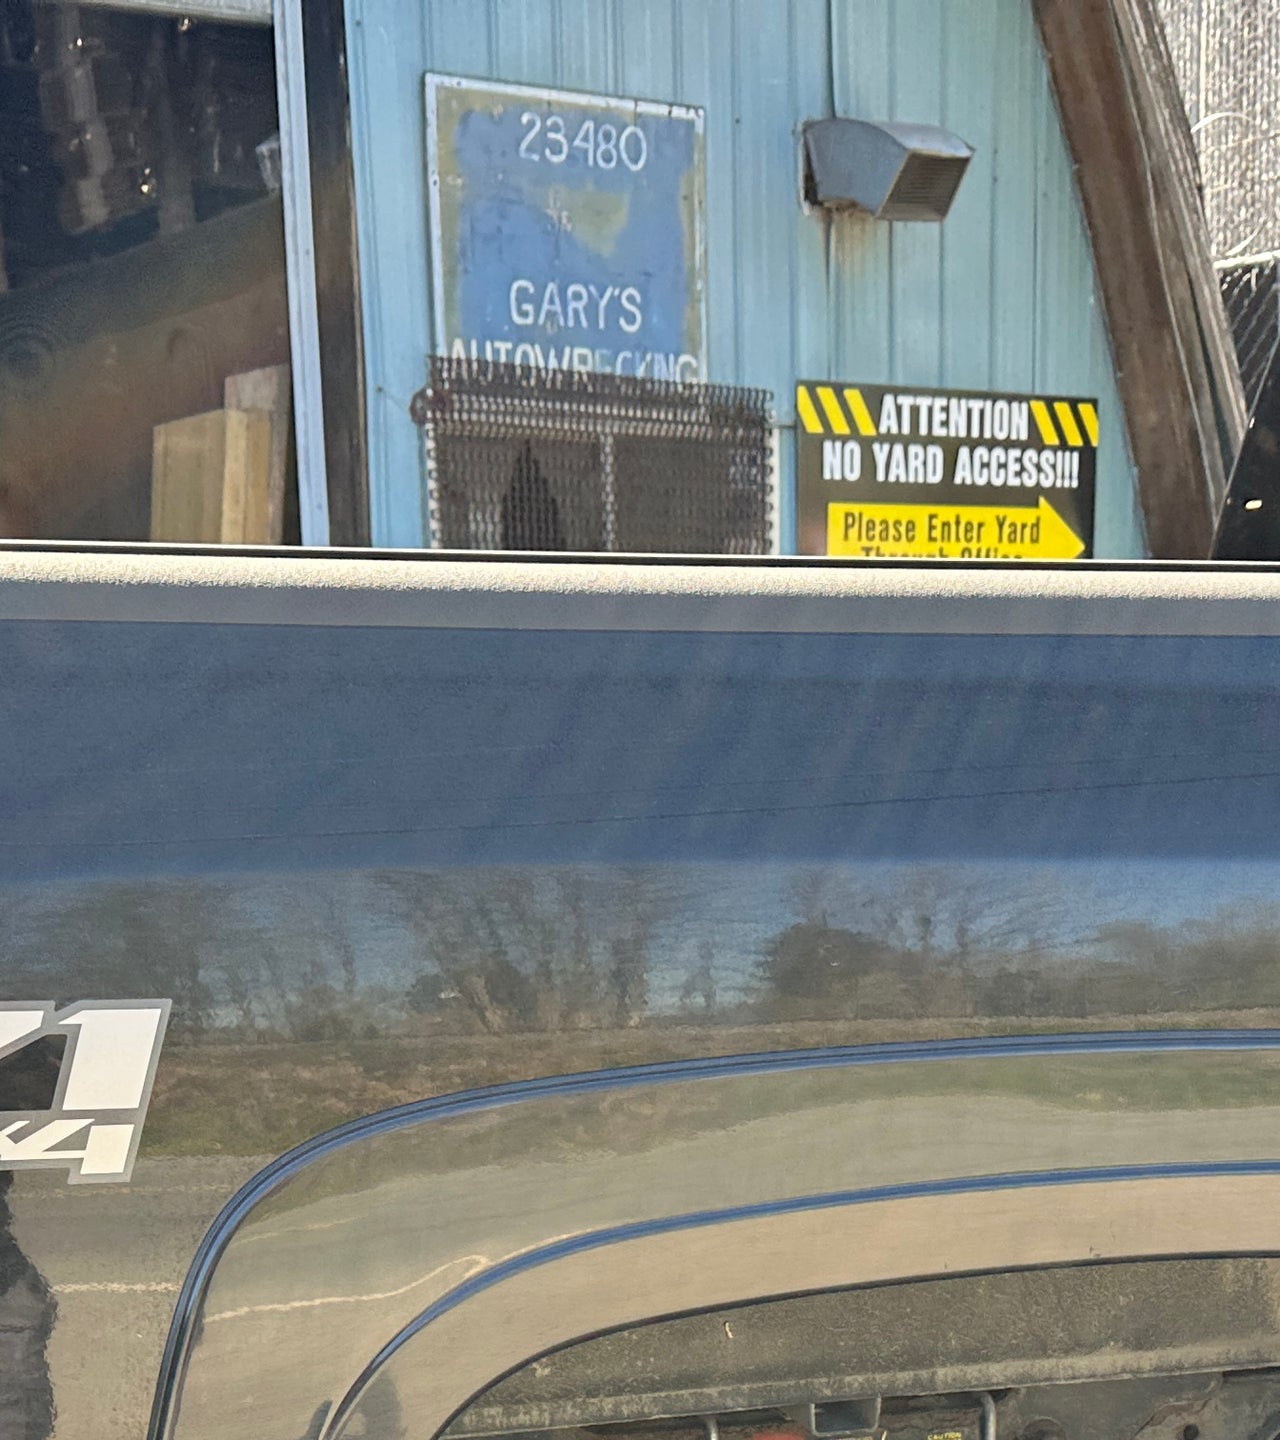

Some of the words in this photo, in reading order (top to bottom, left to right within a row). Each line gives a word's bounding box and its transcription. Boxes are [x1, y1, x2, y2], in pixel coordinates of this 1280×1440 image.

[519, 111, 648, 172] 23480
[509, 279, 643, 334] GARY'S
[878, 393, 1030, 442] ATTENTION
[822, 439, 862, 482] NO
[872, 442, 944, 485] YARD
[953, 446, 1080, 489] ACCESS!!!
[843, 511, 916, 542] Please
[927, 513, 985, 545] Enter
[995, 515, 1041, 545] Yard
